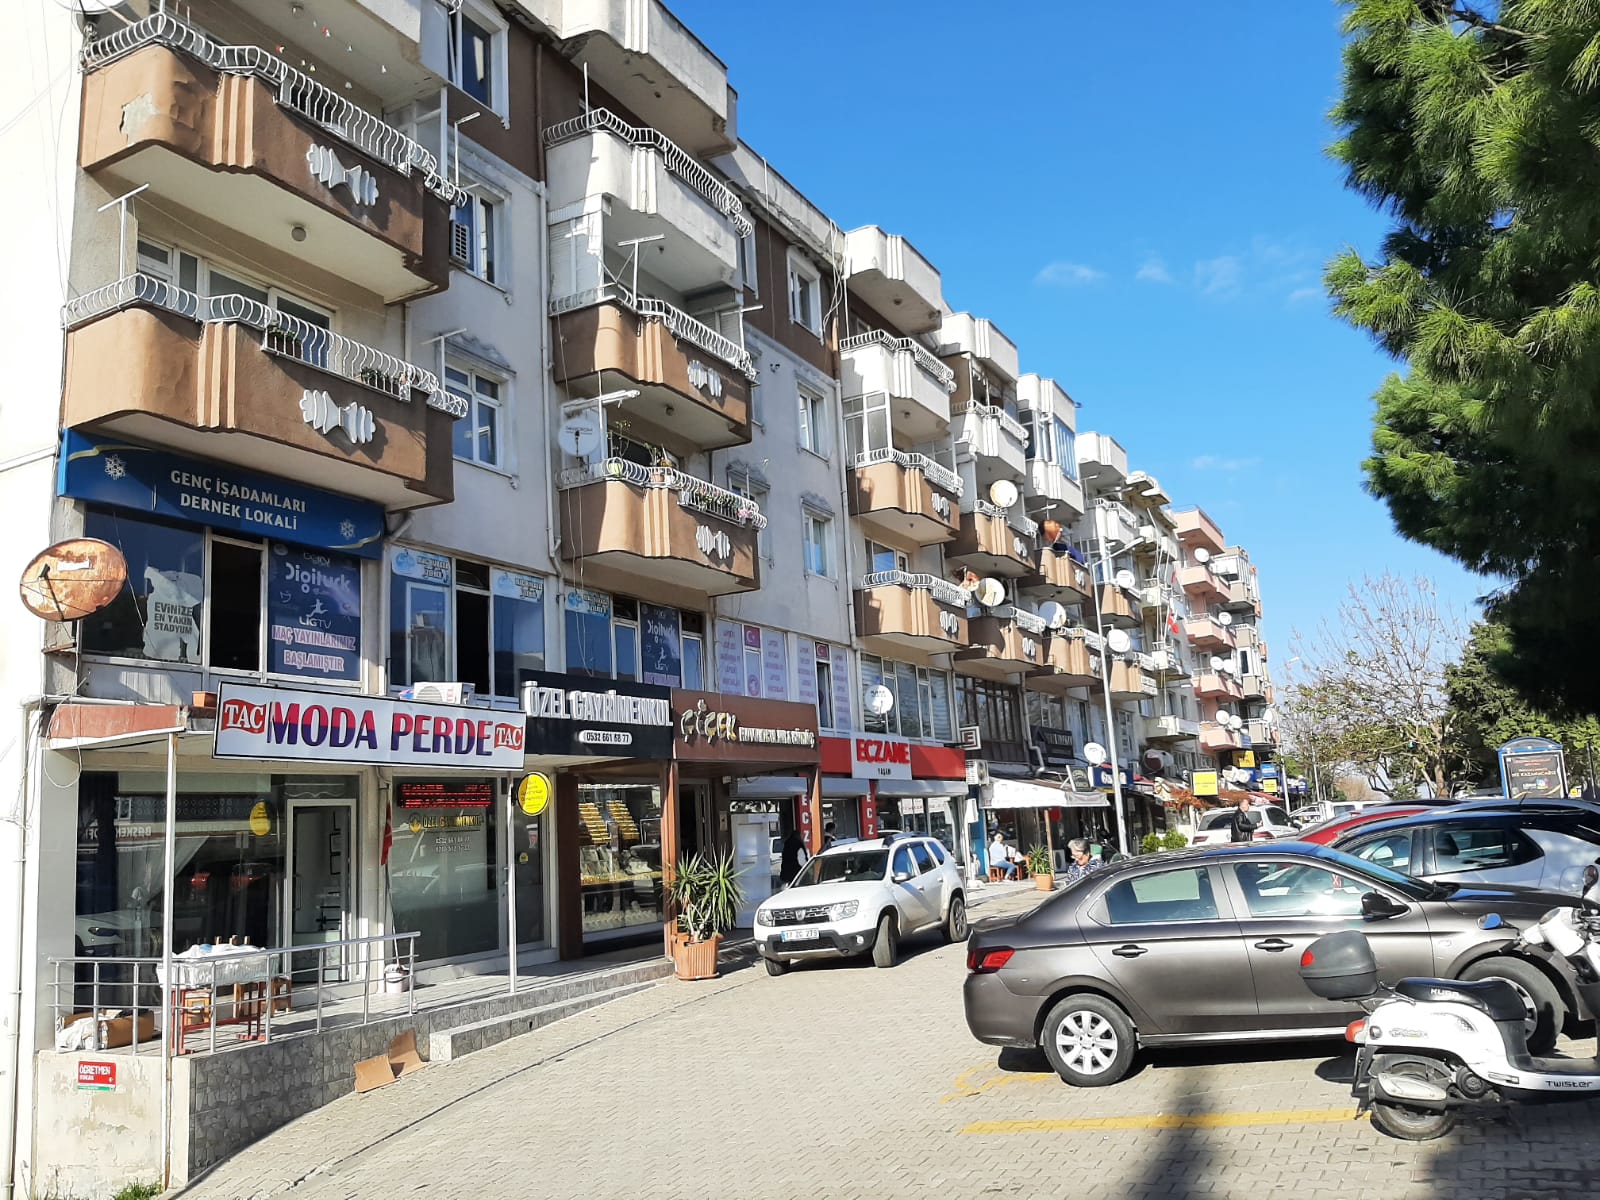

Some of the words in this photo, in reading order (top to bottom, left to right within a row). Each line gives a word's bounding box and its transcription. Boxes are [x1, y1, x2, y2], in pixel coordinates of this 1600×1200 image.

[170, 470, 212, 493] GENÇ
[216, 478, 306, 513] İŞADAMLARI
[180, 493, 241, 518] DERNEK
[245, 508, 297, 530] LOKALİ
[154, 613, 165, 622] EN
[168, 615, 192, 626] YAKIN
[154, 622, 192, 635] STADYUM
[272, 625, 294, 645] MAÇ
[284, 650, 344, 672] BAŞLAMIŞTIR
[524, 680, 570, 720] ÖZEL
[267, 701, 378, 749] MODA
[390, 712, 493, 756] PERDE
[856, 738, 911, 765] ECZANE
